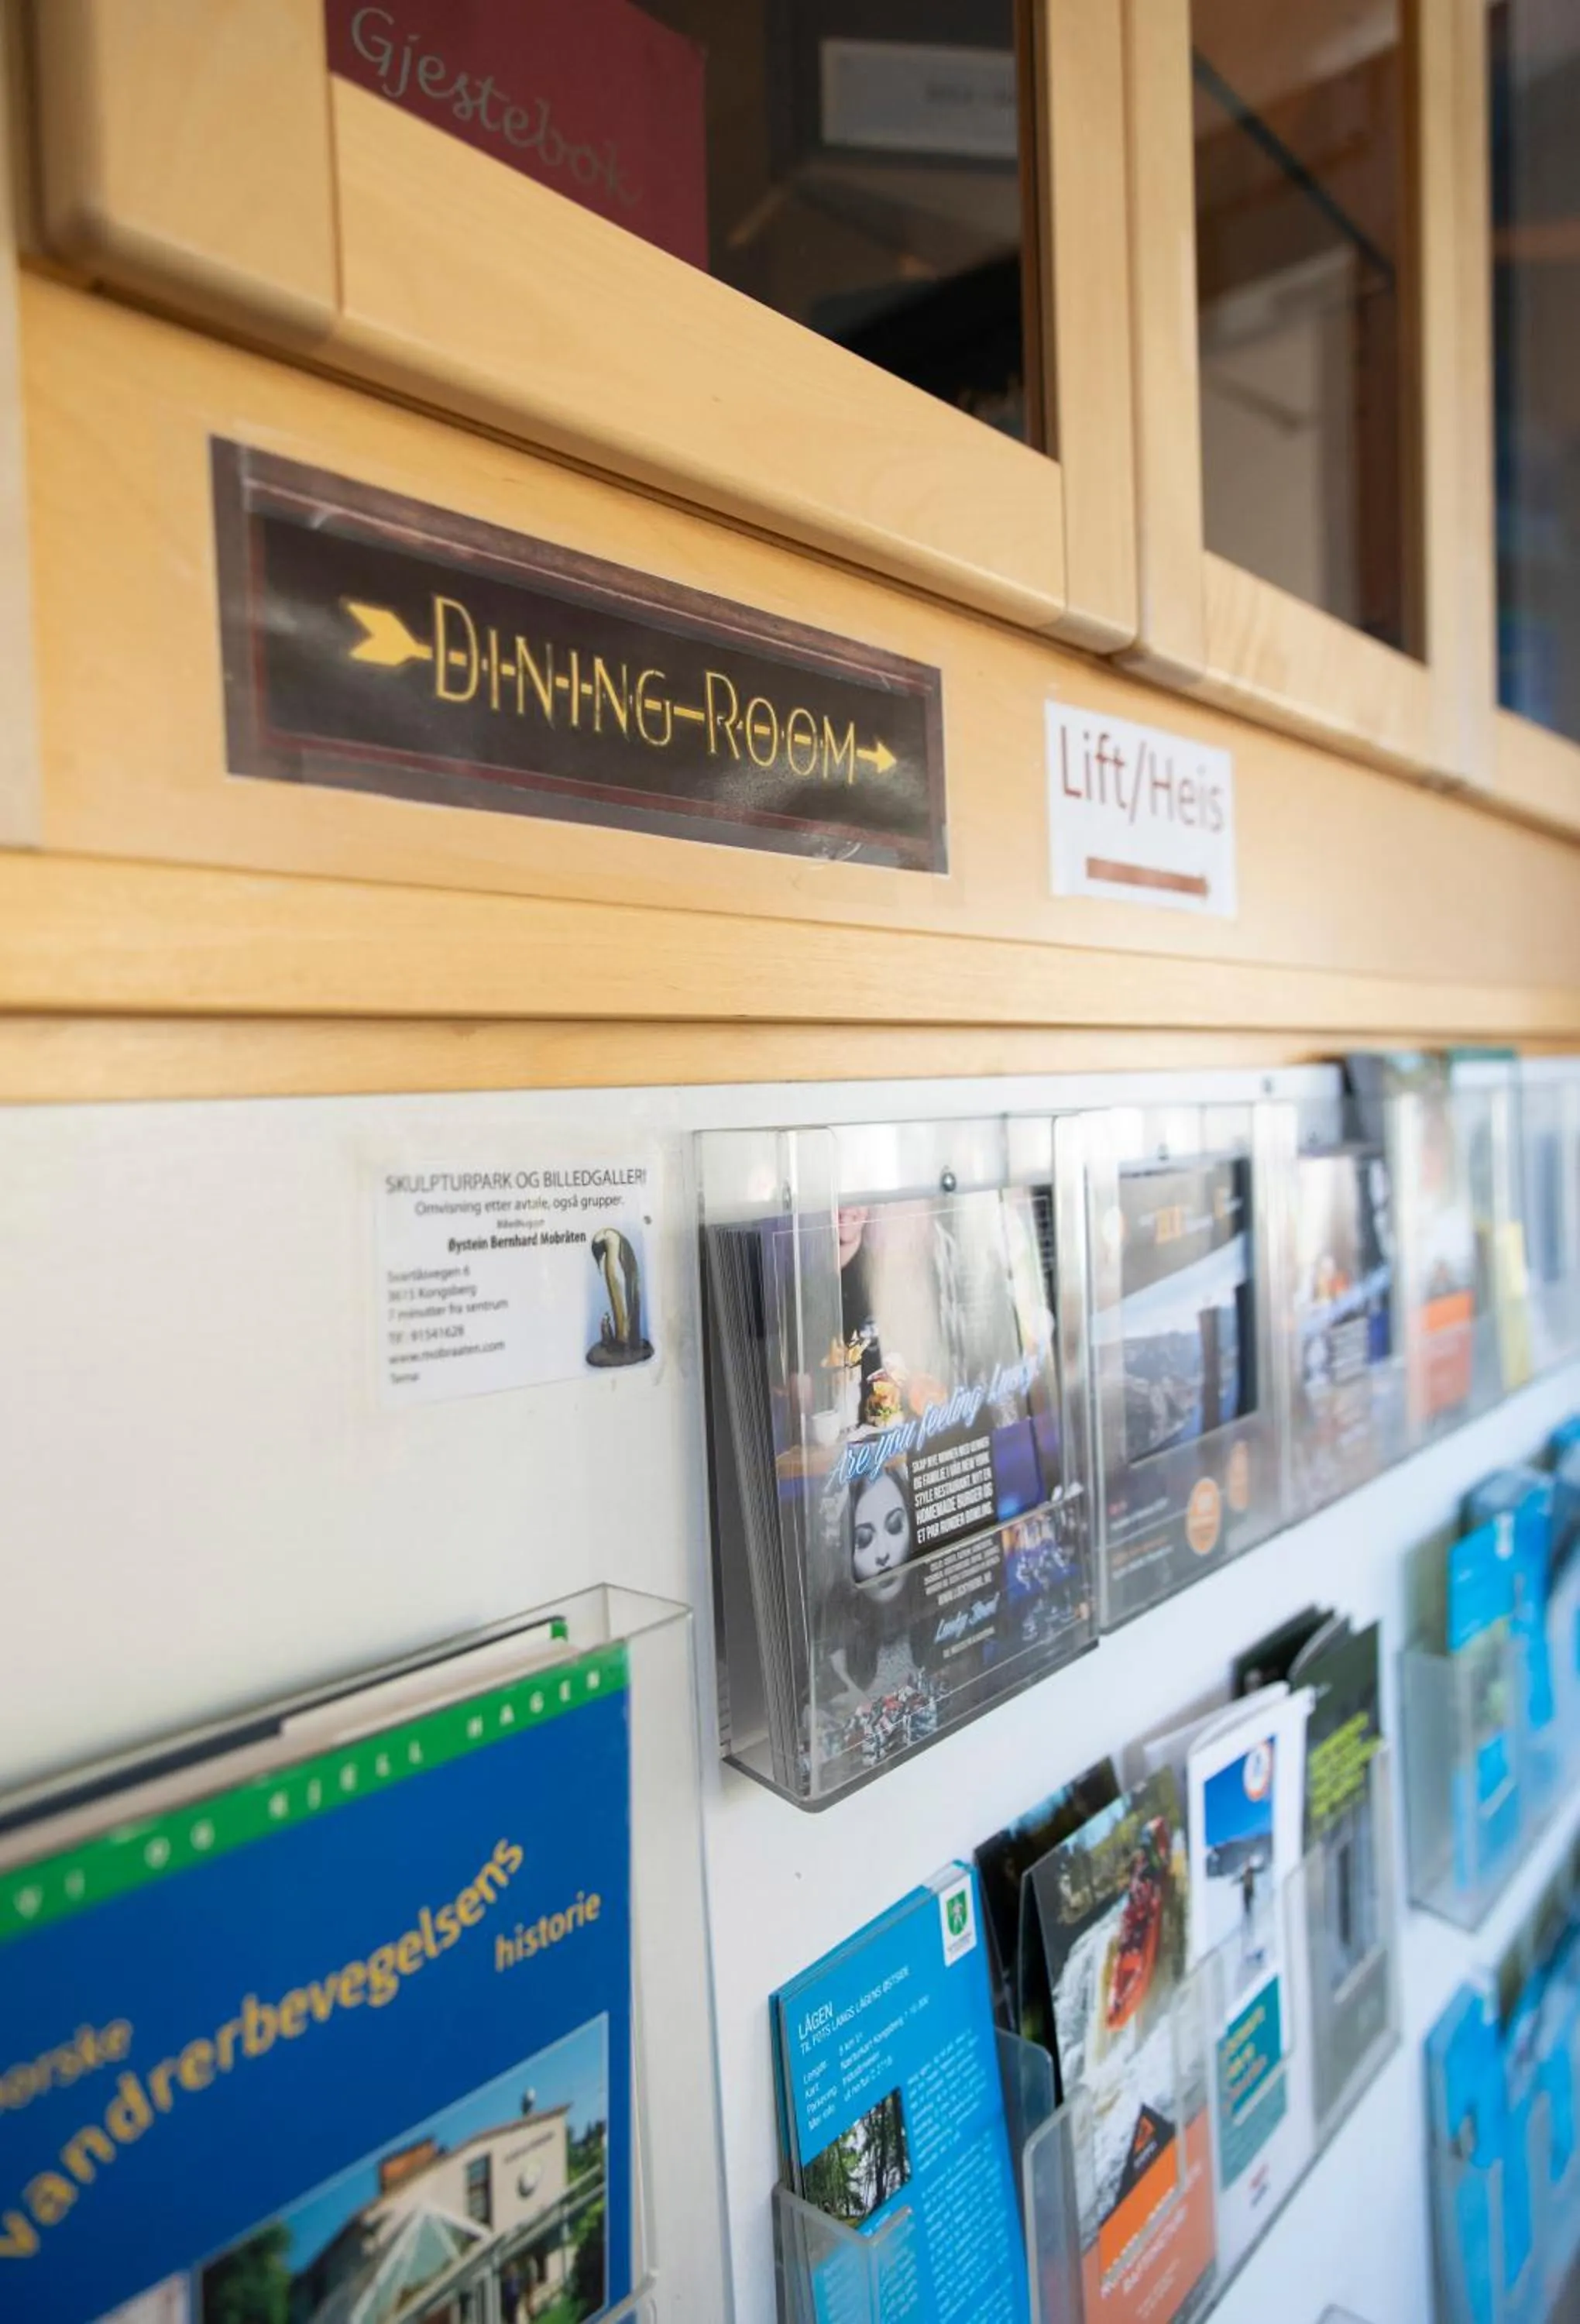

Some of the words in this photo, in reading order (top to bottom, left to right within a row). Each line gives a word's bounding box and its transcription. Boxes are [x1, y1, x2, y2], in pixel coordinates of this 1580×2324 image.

[350, 6, 641, 208] Gjestebok
[432, 595, 675, 747] DINING
[704, 671, 857, 785] ROOM
[1060, 724, 1224, 834] Lift/Heis
[386, 1171, 512, 1194] SKULPTURPARK
[517, 1171, 540, 1189] OG
[544, 1168, 647, 1188] BILLEDGALLERI
[414, 1201, 482, 1217] Omvisning
[485, 1200, 511, 1213] etter
[514, 1199, 551, 1212] avtale,
[553, 1194, 578, 1211] også
[448, 1236, 488, 1254] Øystein
[490, 1232, 538, 1250] Bernhard
[541, 1229, 586, 1245] Mobråten
[869, 1419, 917, 1483] you
[915, 1384, 984, 1452] feeling
[495, 1890, 602, 1973] historie
[799, 2000, 833, 2040] LÅGEN
[832, 2005, 855, 2032] LANGS
[0, 2017, 134, 2110] orske
